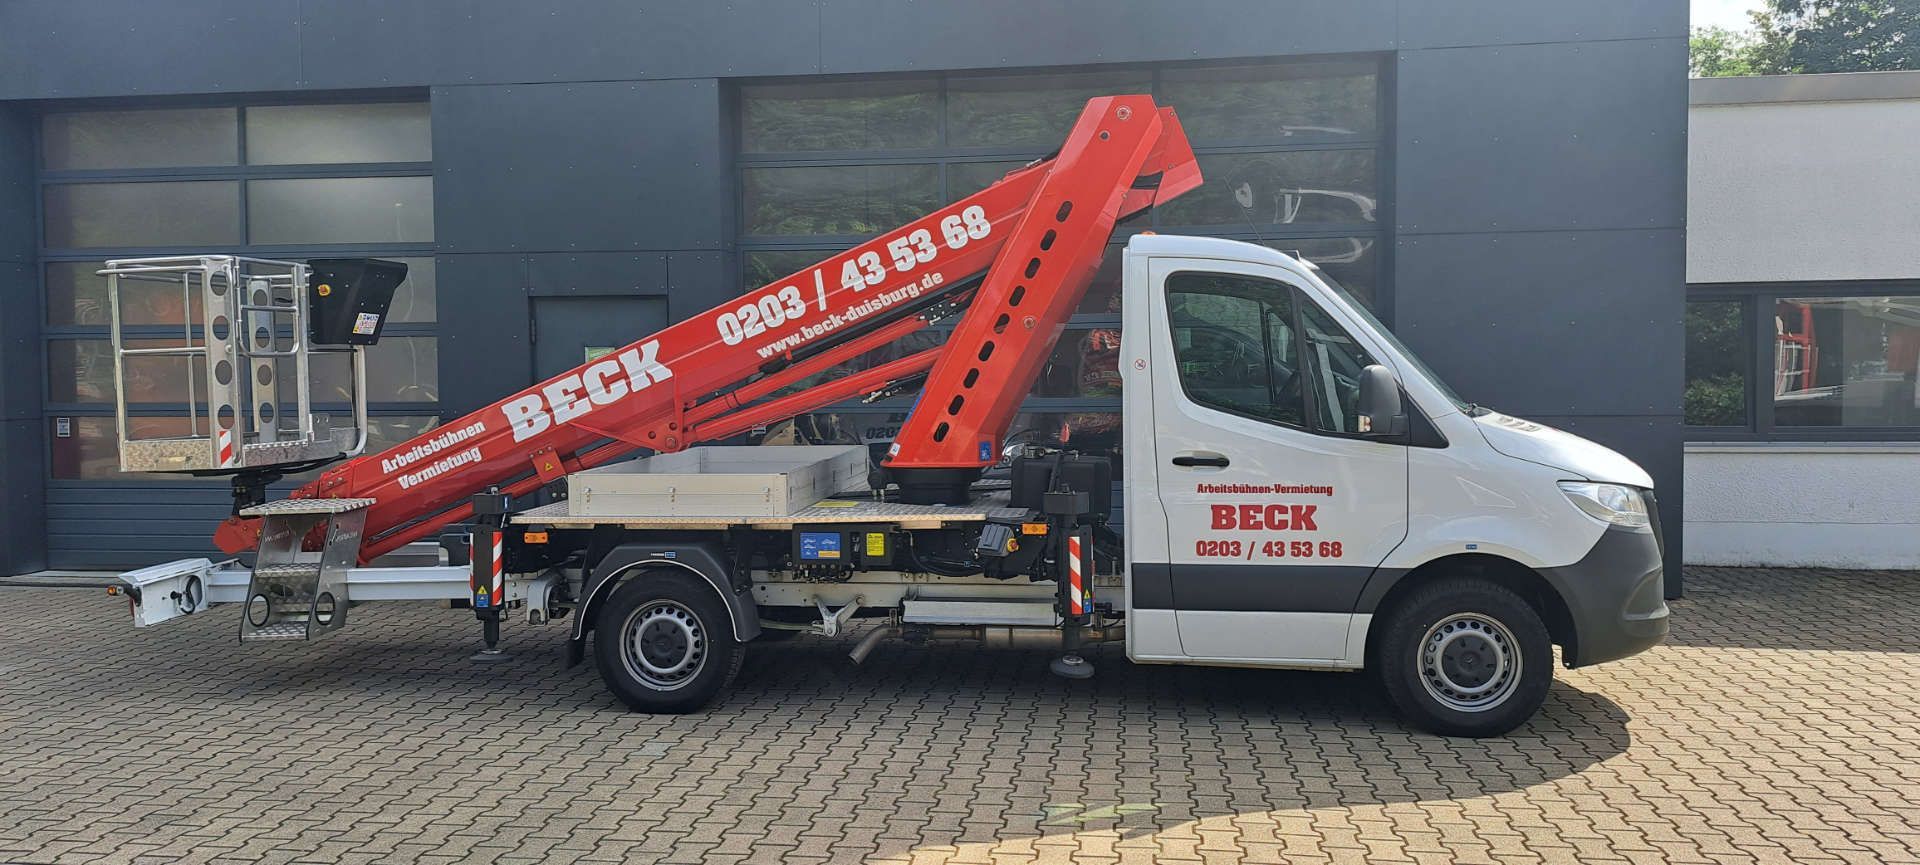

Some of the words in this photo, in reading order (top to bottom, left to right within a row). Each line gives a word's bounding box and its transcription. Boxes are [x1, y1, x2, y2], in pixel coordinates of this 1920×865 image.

[716, 285, 807, 346] 0203
[814, 268, 827, 312] /
[841, 251, 887, 292] 43
[887, 229, 937, 272] 53
[941, 205, 991, 249] 68
[756, 270, 944, 359] www.beck-duisburg.de
[501, 339, 673, 443] BECK
[381, 421, 486, 474] Arbeitsbühnen
[398, 447, 483, 490] Vermietung
[1197, 483, 1333, 497] Arbeitsbühnen-Vermietung
[1211, 504, 1318, 531] BECK
[1195, 540, 1242, 557] 0203
[1247, 541, 1256, 560] /
[1262, 541, 1286, 557] 43
[1290, 541, 1314, 557] 53
[1318, 541, 1343, 557] 68
